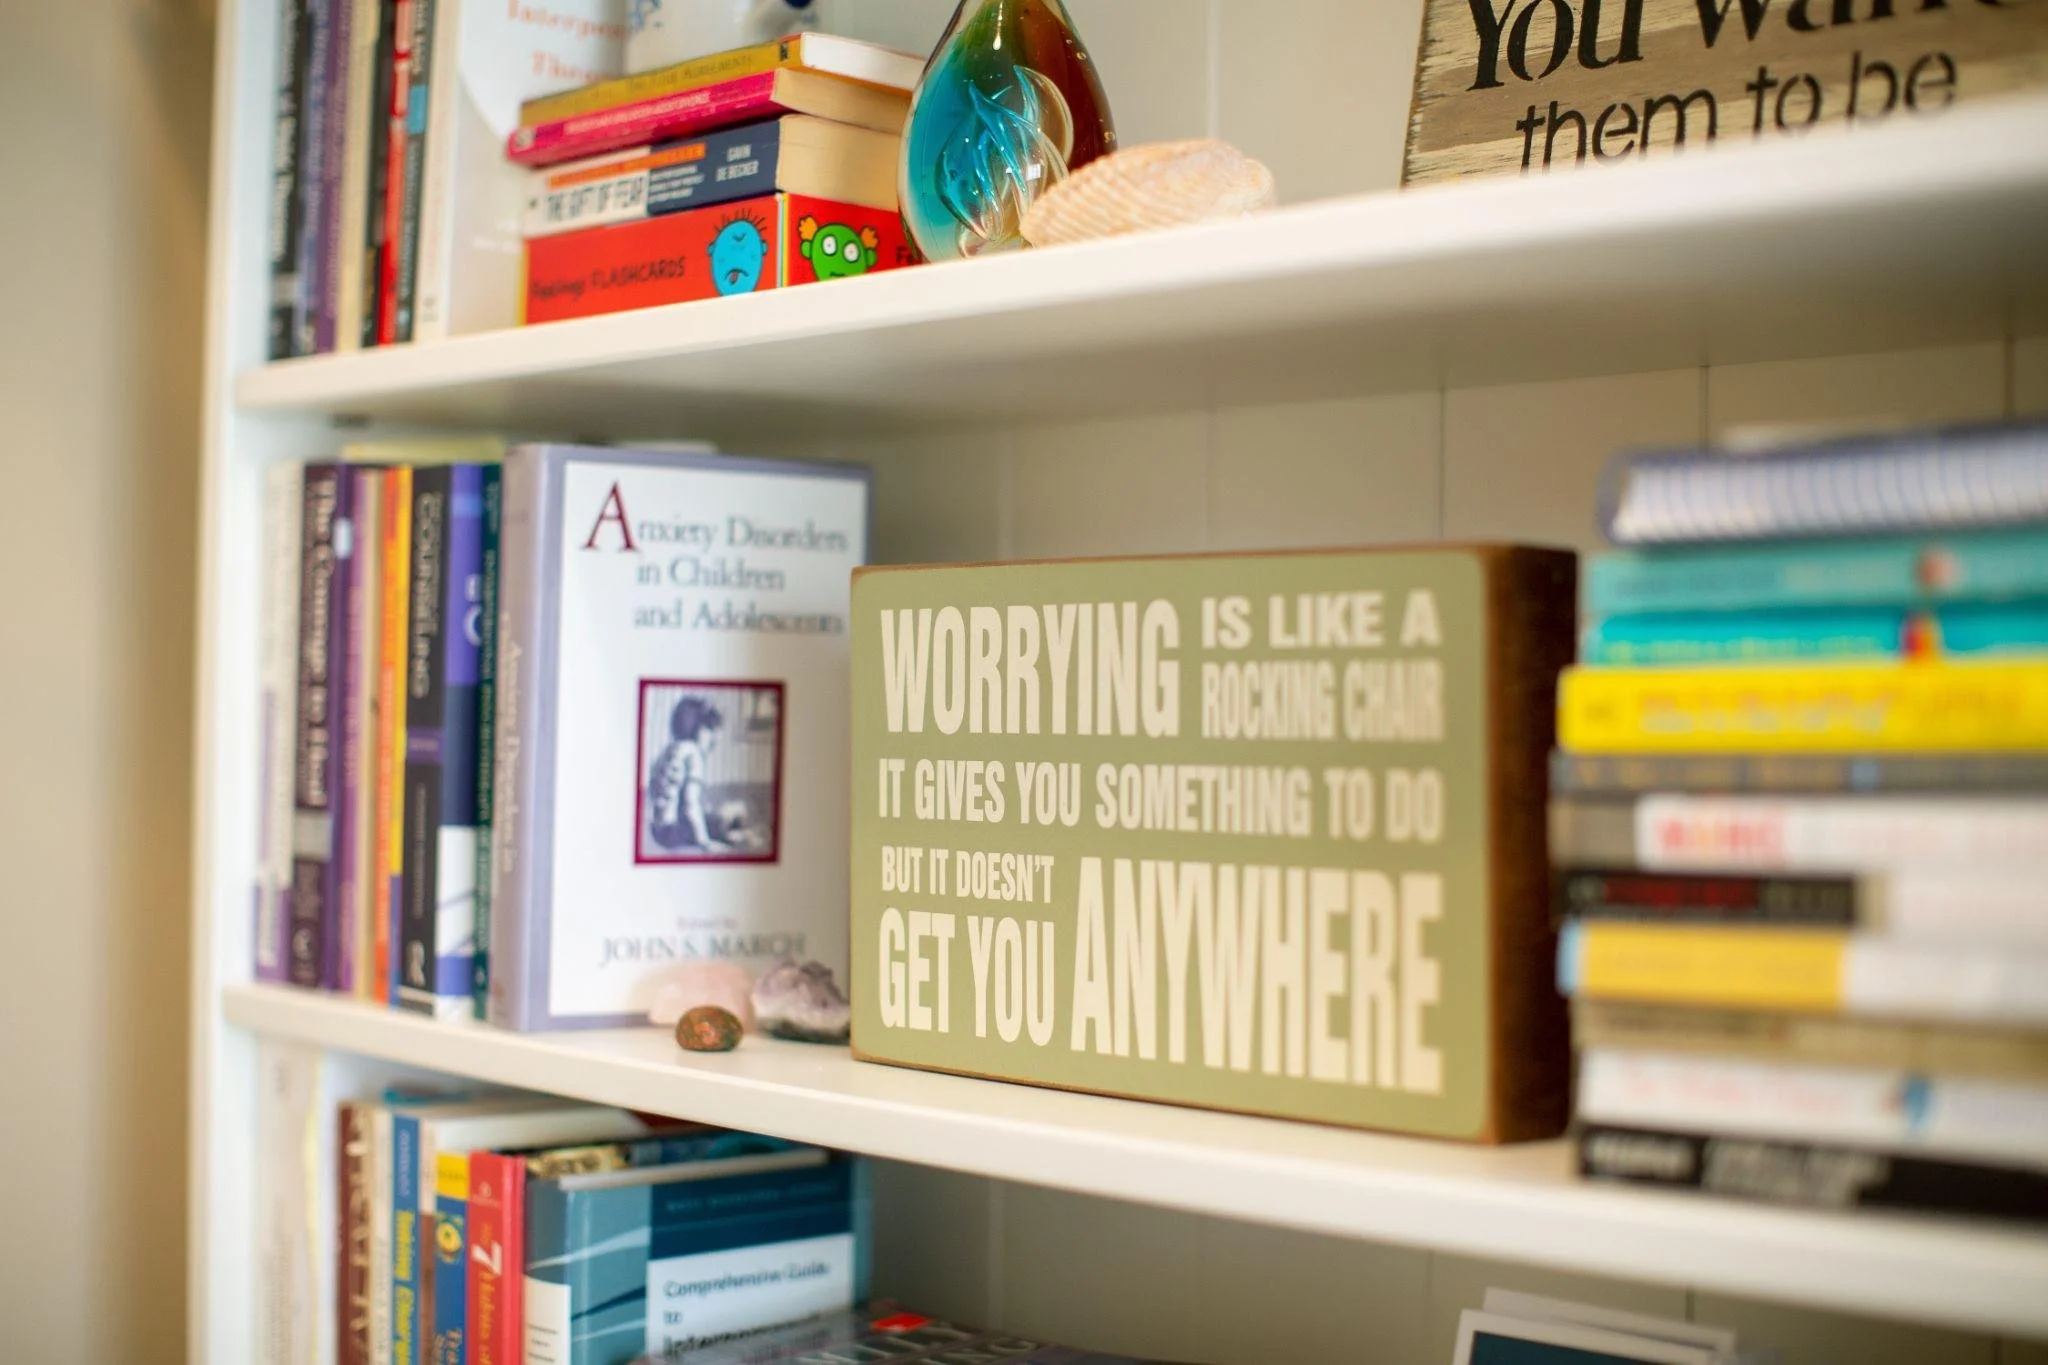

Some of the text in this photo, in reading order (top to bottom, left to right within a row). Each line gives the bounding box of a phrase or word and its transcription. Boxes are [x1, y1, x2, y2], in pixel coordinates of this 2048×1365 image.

[1515, 50, 1957, 176] them to be
[583, 481, 847, 553] Anxiety Disorders
[637, 555, 786, 591] in Children
[634, 598, 844, 634] and Adolescents
[880, 590, 1443, 738] WORRYING IS LIKE A
[1201, 657, 1445, 743] ROCKING CHAIR
[879, 758, 1444, 844] IT GIVES YOU SOMETHING TO DO
[881, 845, 1055, 904] BUT IT DOESN'T
[598, 935, 678, 968] JOHN
[879, 855, 1444, 1095] GET YOU ANYWHERE
[471, 1240, 502, 1276] 7
